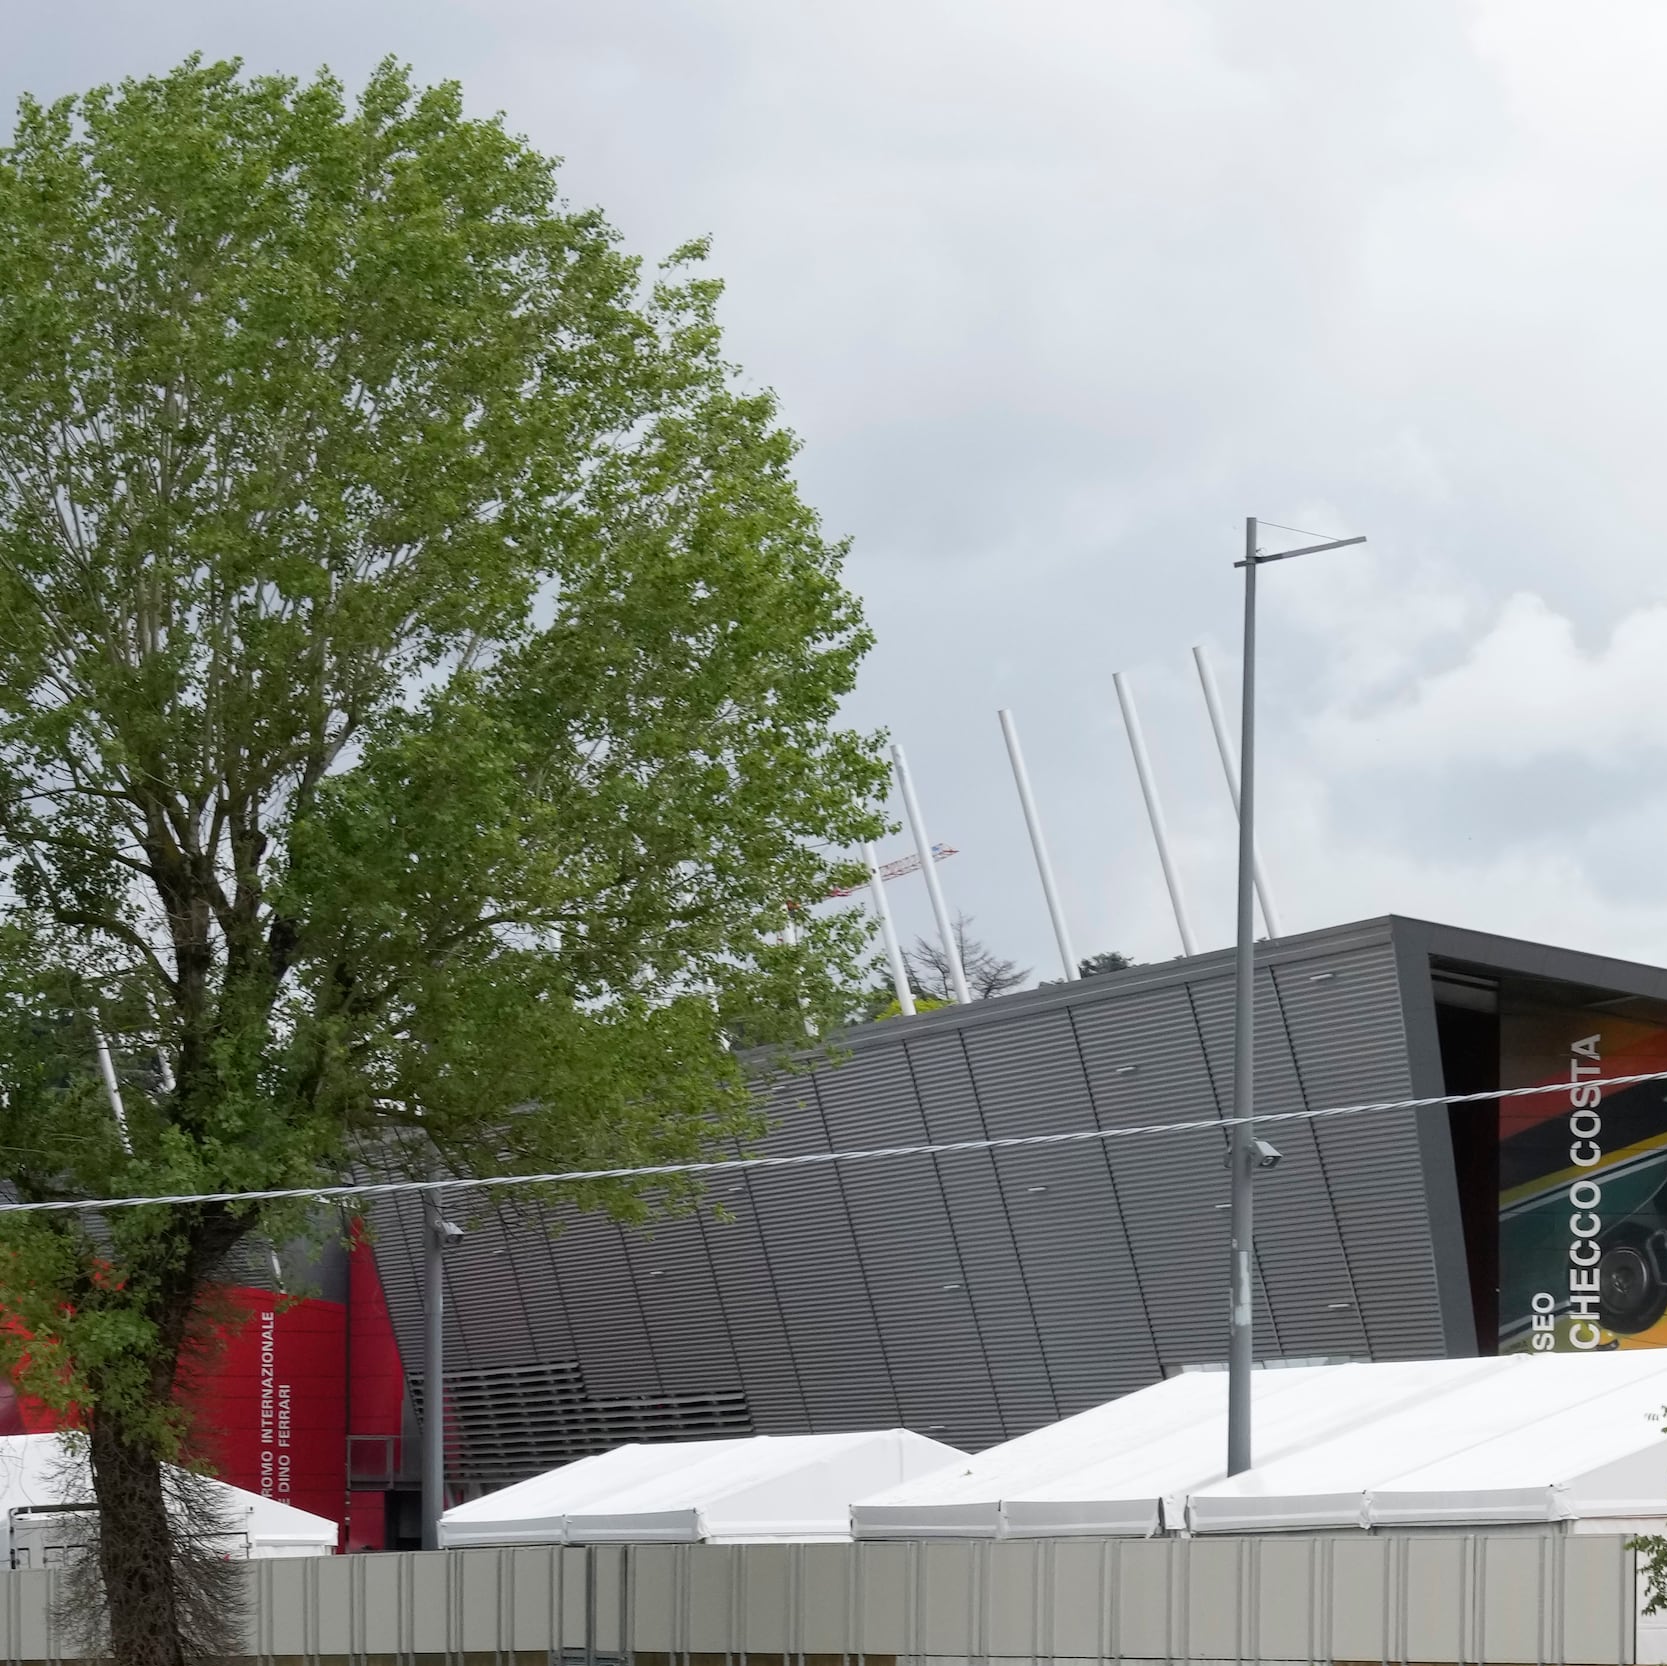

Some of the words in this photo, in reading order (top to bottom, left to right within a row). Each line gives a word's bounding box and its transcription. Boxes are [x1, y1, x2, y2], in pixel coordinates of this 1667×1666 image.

[1569, 1033, 1602, 1168] COSTA
[1569, 1180, 1602, 1349] CHECCO
[261, 1311, 275, 1444] INTERNAZIONALE
[278, 1384, 291, 1448] FERRARI
[278, 1454, 291, 1494] DINO
